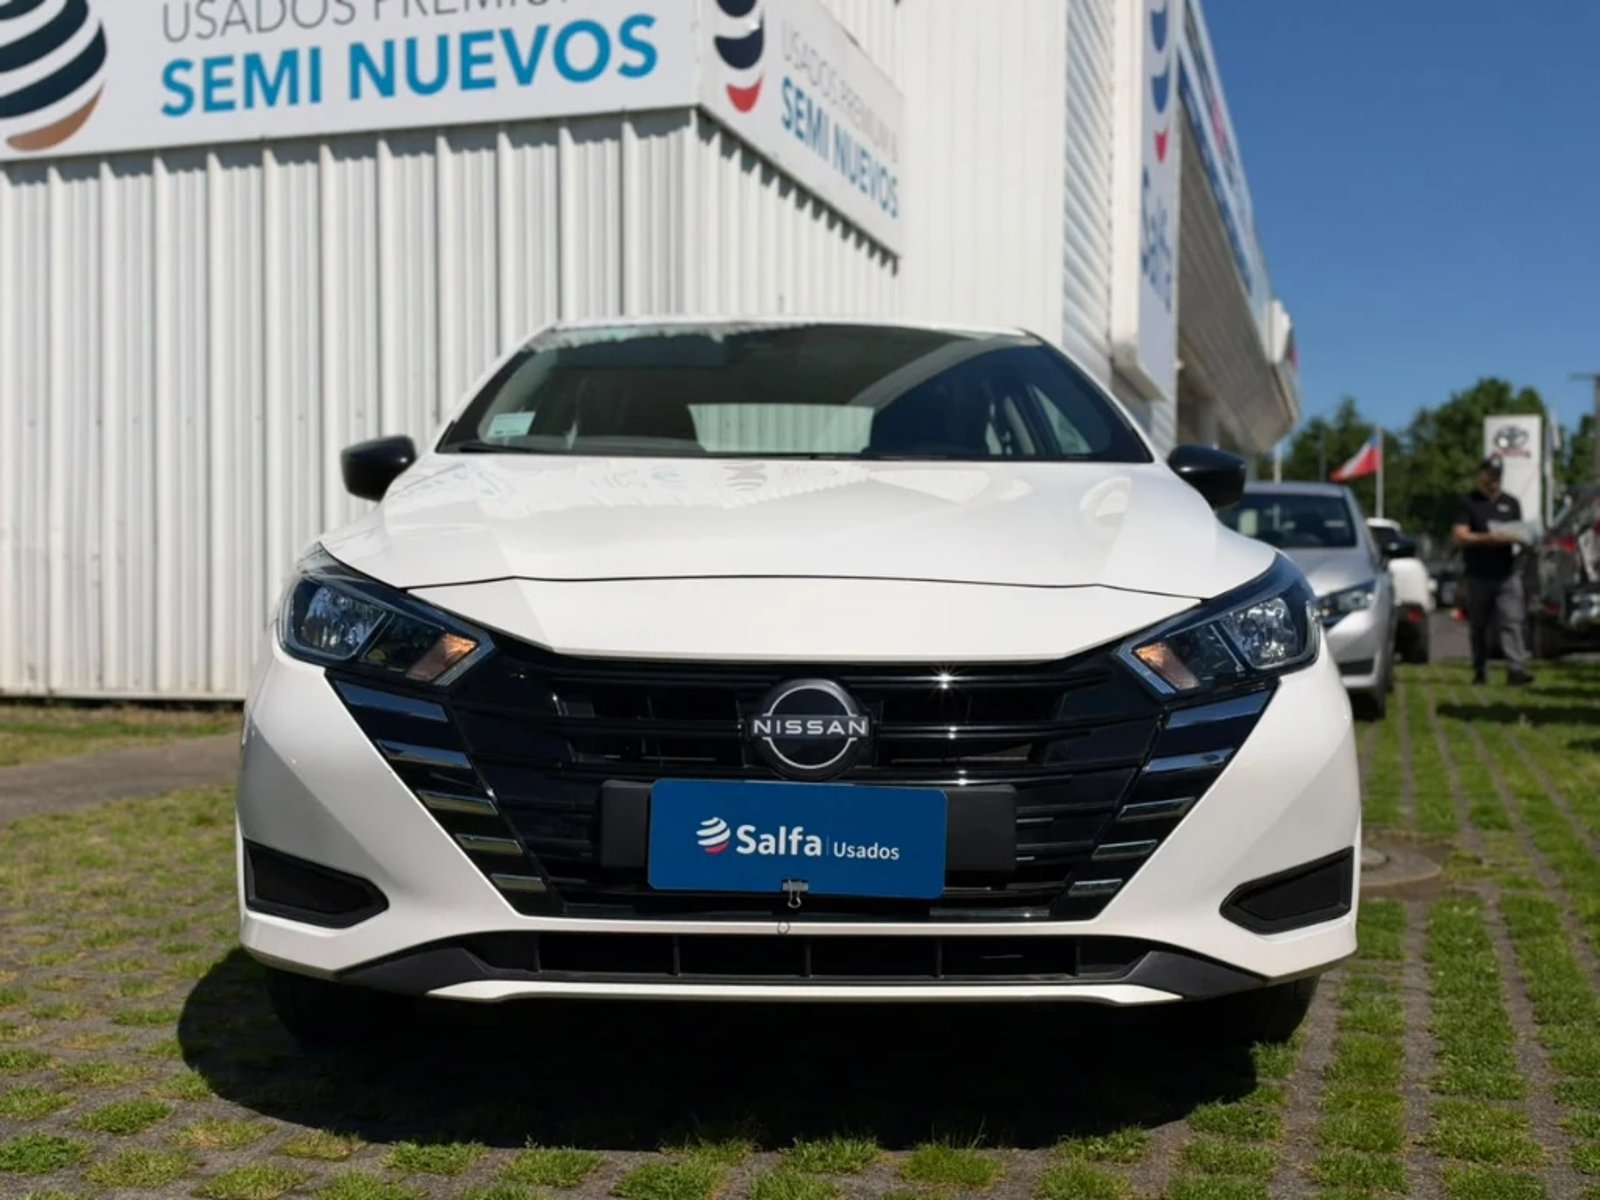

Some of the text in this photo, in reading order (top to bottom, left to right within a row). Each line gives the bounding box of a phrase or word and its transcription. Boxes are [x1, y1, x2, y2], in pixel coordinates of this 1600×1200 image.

[162, 0, 357, 43] USADOS
[161, 13, 658, 118] SEMI NUEVOS
[781, 75, 829, 162] SEMI
[753, 719, 868, 735] NISSAN
[736, 825, 900, 860] Salfa Usados
